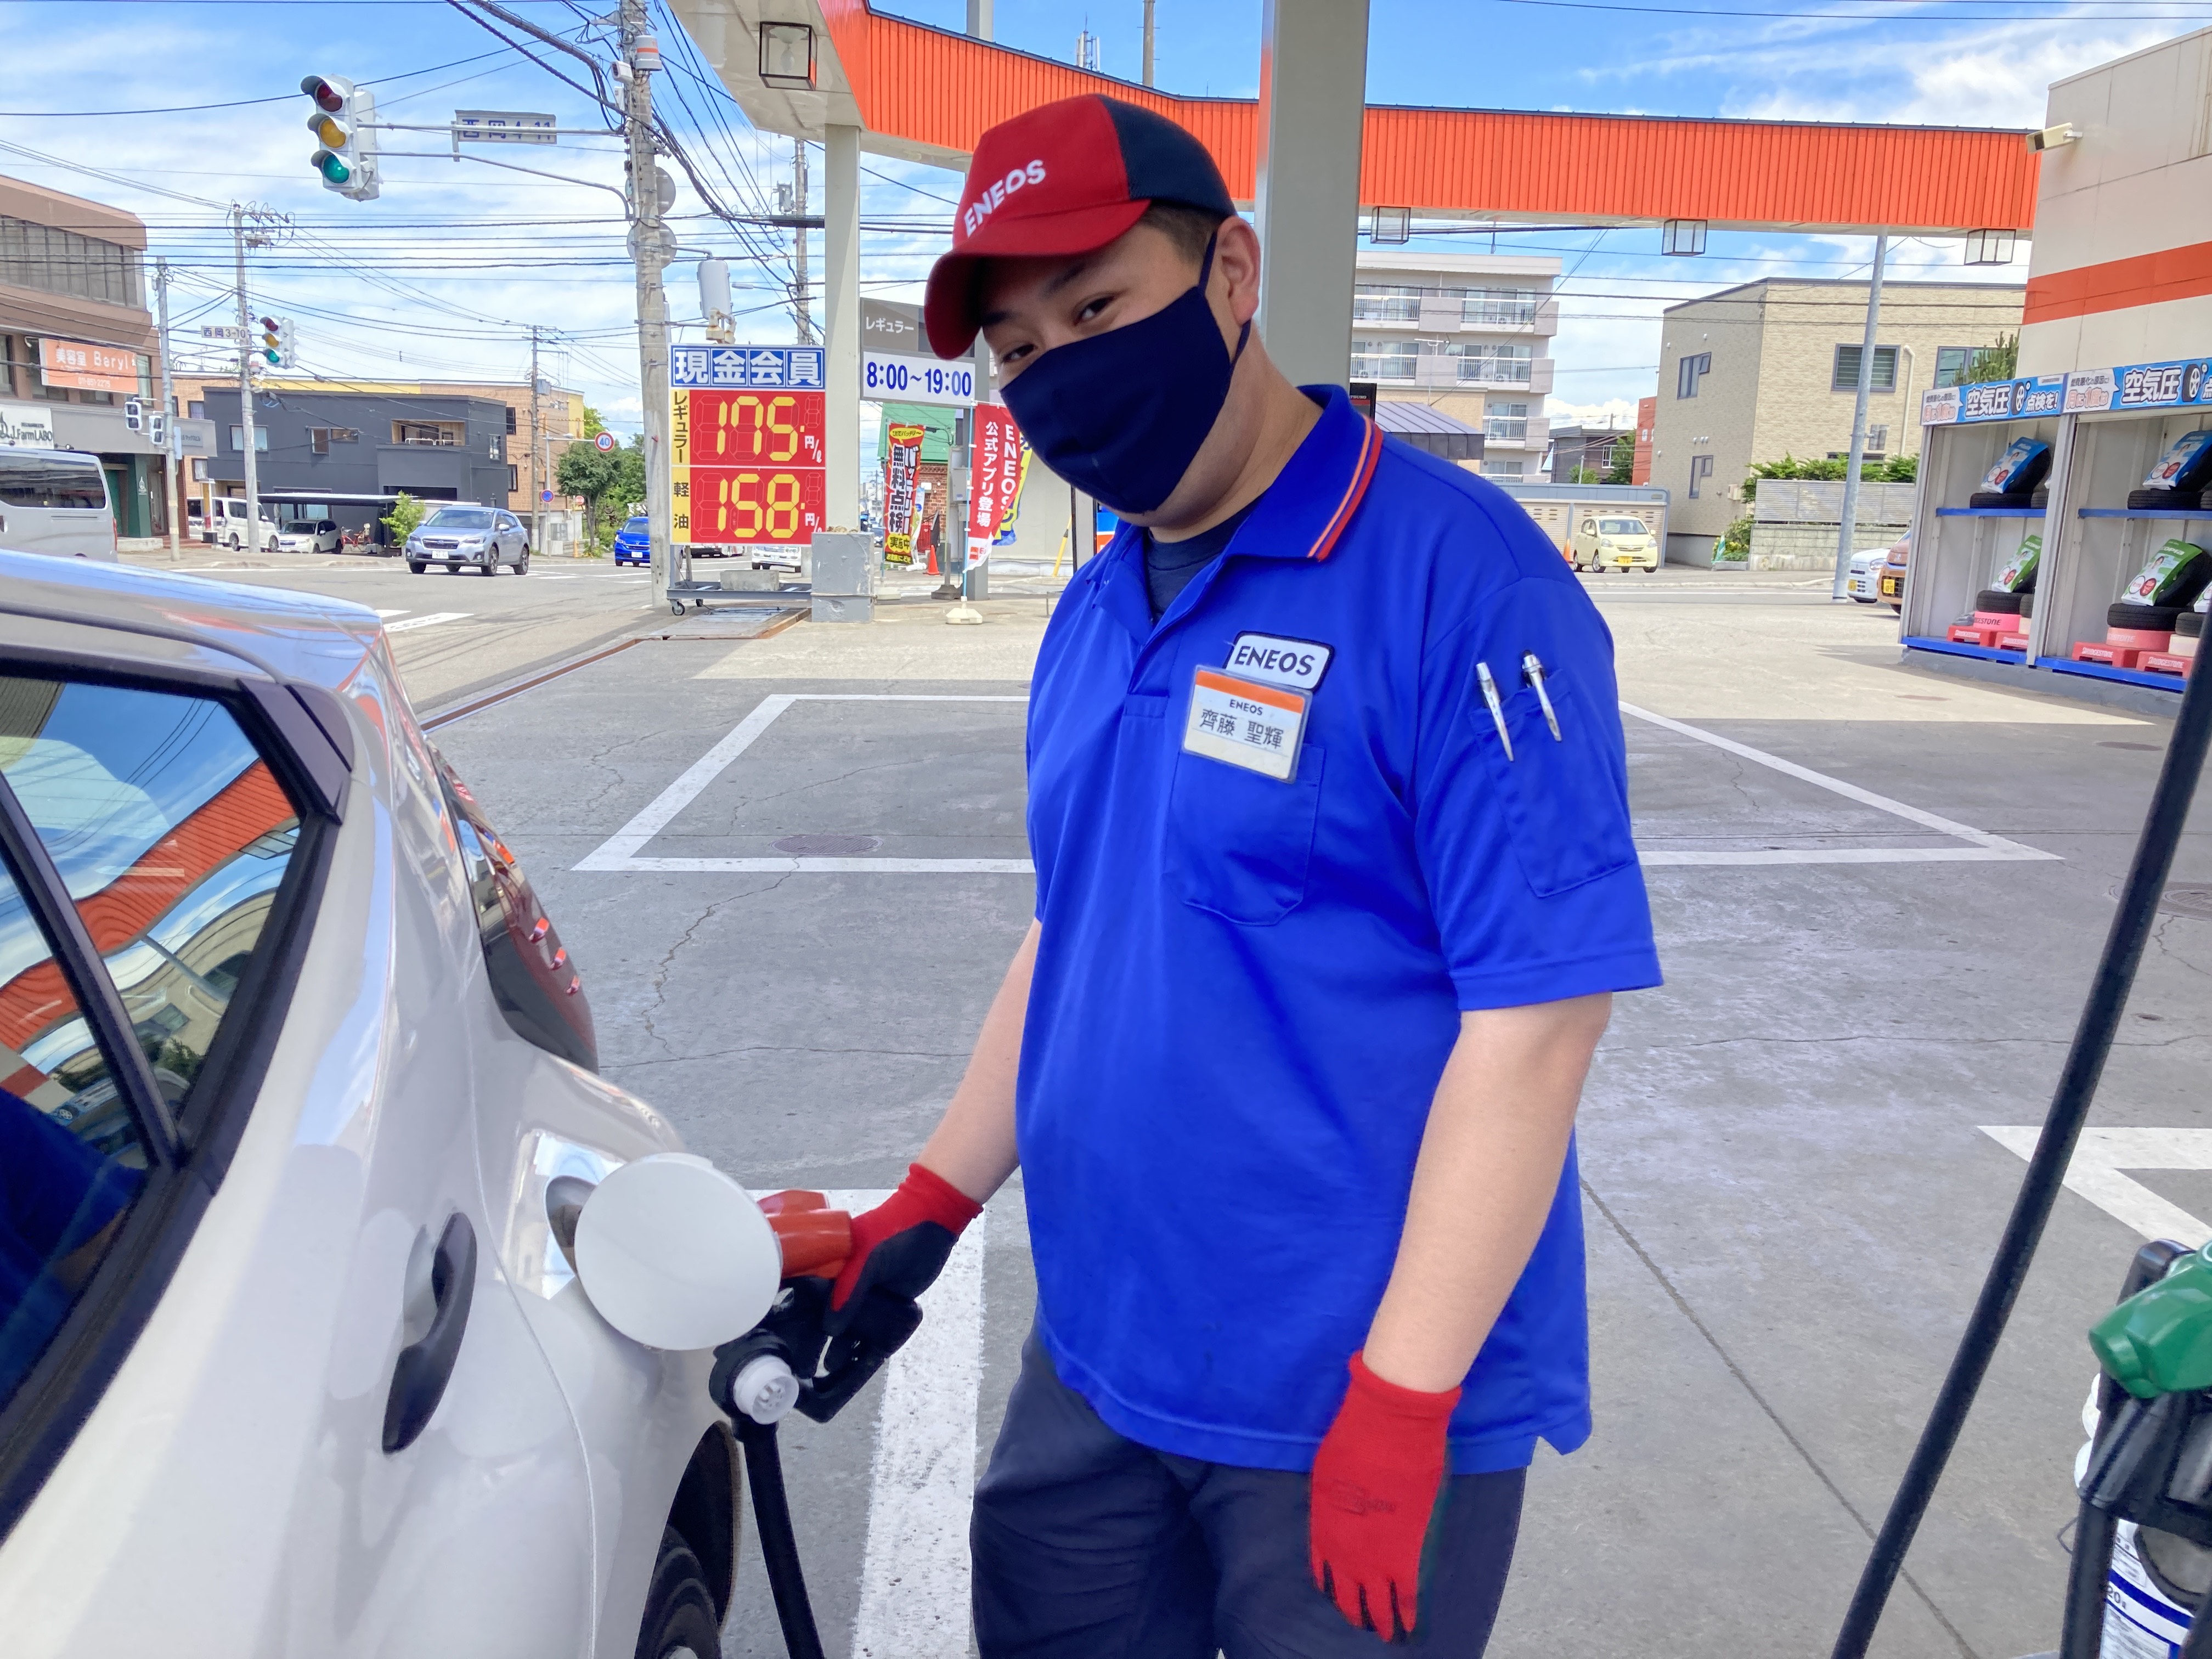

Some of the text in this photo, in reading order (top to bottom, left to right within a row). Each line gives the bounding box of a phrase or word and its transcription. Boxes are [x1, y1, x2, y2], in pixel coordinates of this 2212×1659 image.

[964, 159, 1046, 238] ENEOS
[204, 328, 245, 338] 西岡3-10
[866, 316, 915, 334] レギュラー
[56, 348, 128, 371] 美容室 Beryl
[675, 350, 821, 385] 現金会員
[1965, 385, 2011, 417] 空気圧
[2121, 366, 2182, 404] 空気圧
[600, 438, 610, 446] 40
[673, 392, 688, 463] レギュラー
[889, 444, 905, 533] 無料点検
[904, 445, 919, 534] バッテリー
[977, 421, 999, 527] 公式アプリ登場
[674, 482, 689, 529] 軽油
[1234, 645, 1315, 676] ENEOS
[1229, 699, 1263, 715] ENEOS
[1244, 720, 1284, 749] 聖輝
